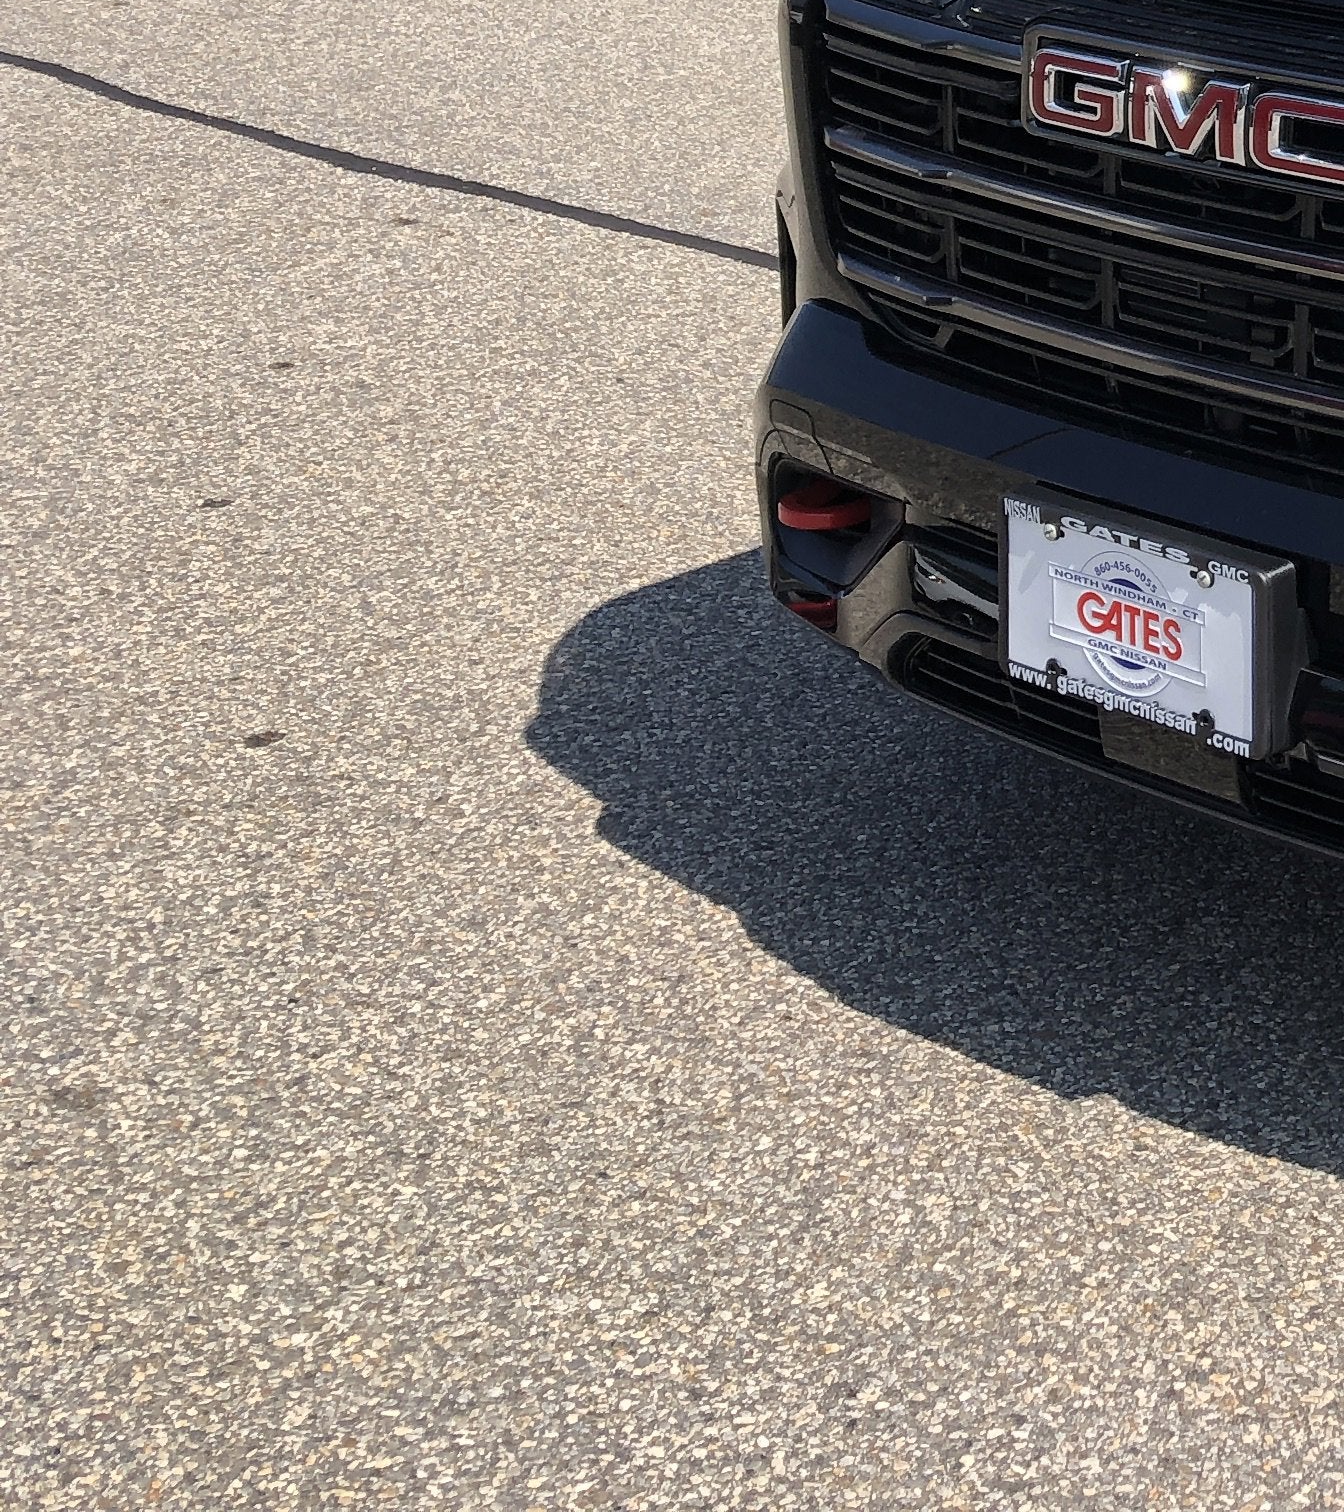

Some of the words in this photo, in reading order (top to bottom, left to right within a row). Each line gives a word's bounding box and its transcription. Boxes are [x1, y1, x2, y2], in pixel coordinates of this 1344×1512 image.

[1004, 497, 1041, 524] NISSAN
[1060, 516, 1190, 565] GATES
[1207, 560, 1250, 584] GMC
[1054, 568, 1099, 588] NORTH
[1102, 582, 1167, 610] WINDHAM
[1182, 609, 1199, 621] CT
[1094, 560, 1157, 594] 860-456-0055
[1076, 591, 1183, 661] GATES
[1087, 638, 1119, 655] GMC
[1120, 647, 1167, 671] NISSAN
